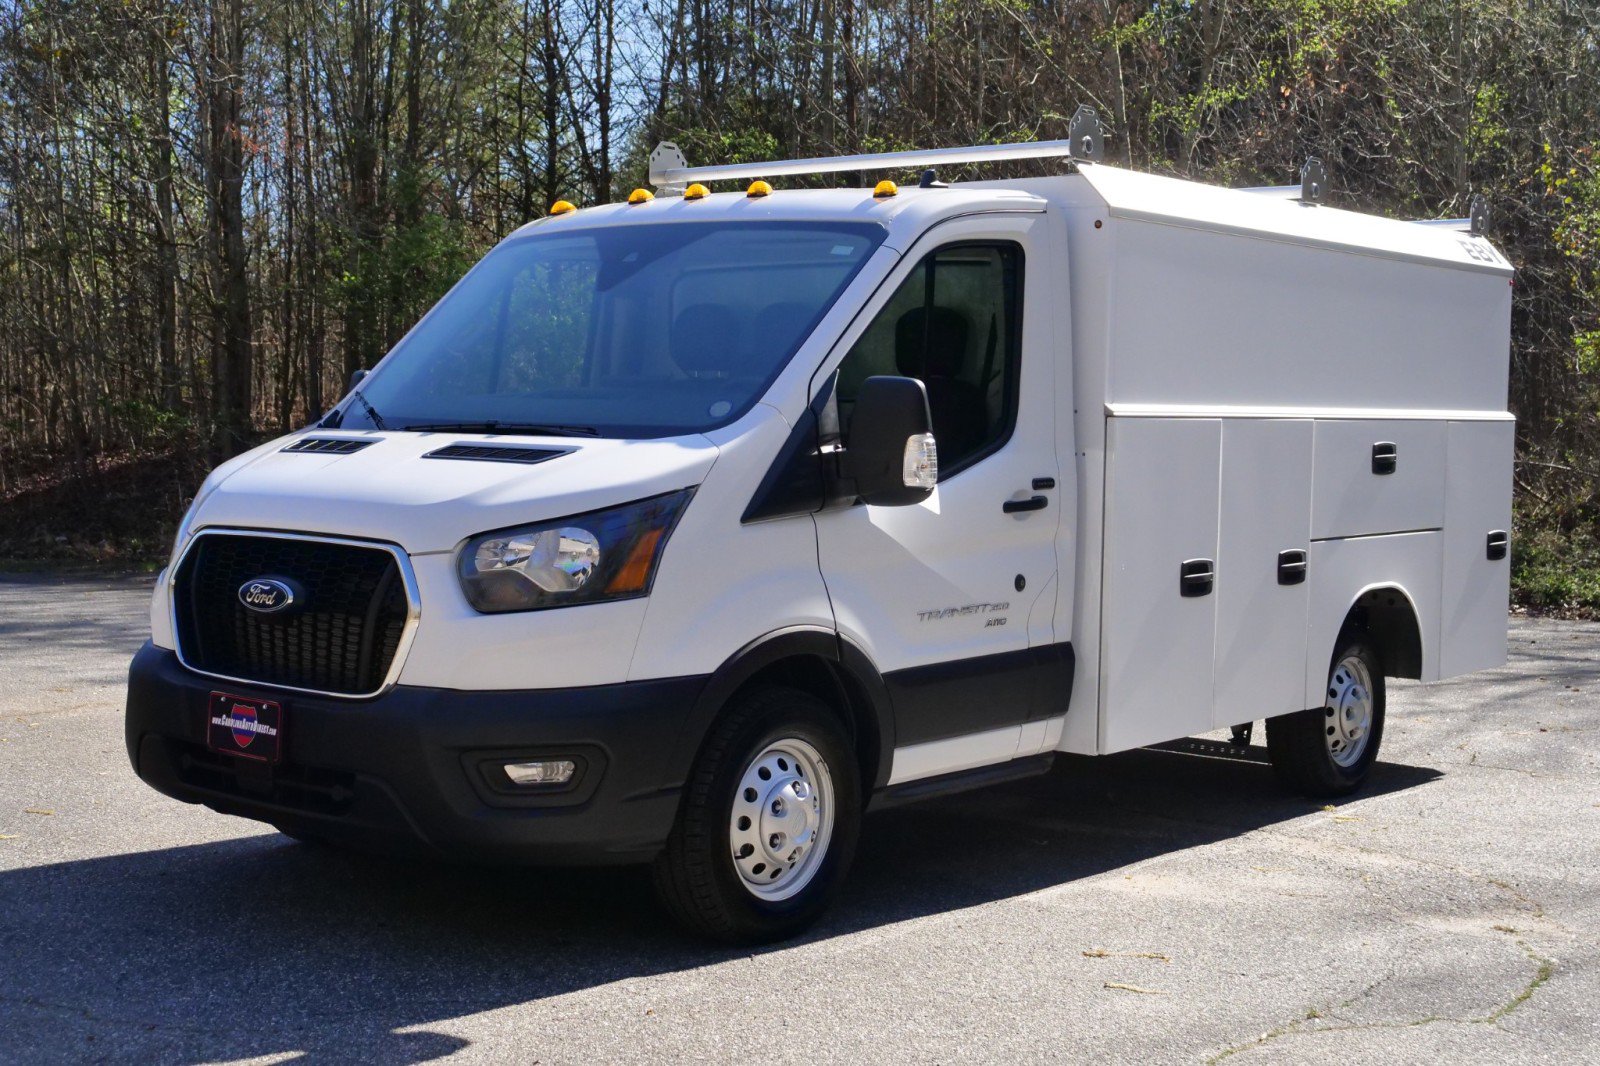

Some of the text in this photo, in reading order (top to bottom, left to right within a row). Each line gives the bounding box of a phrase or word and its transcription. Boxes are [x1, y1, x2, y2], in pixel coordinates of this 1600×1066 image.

[1457, 239, 1502, 264] EBY
[246, 583, 277, 605] Ford
[916, 603, 990, 621] TRANSIT
[984, 617, 1007, 628] AWD
